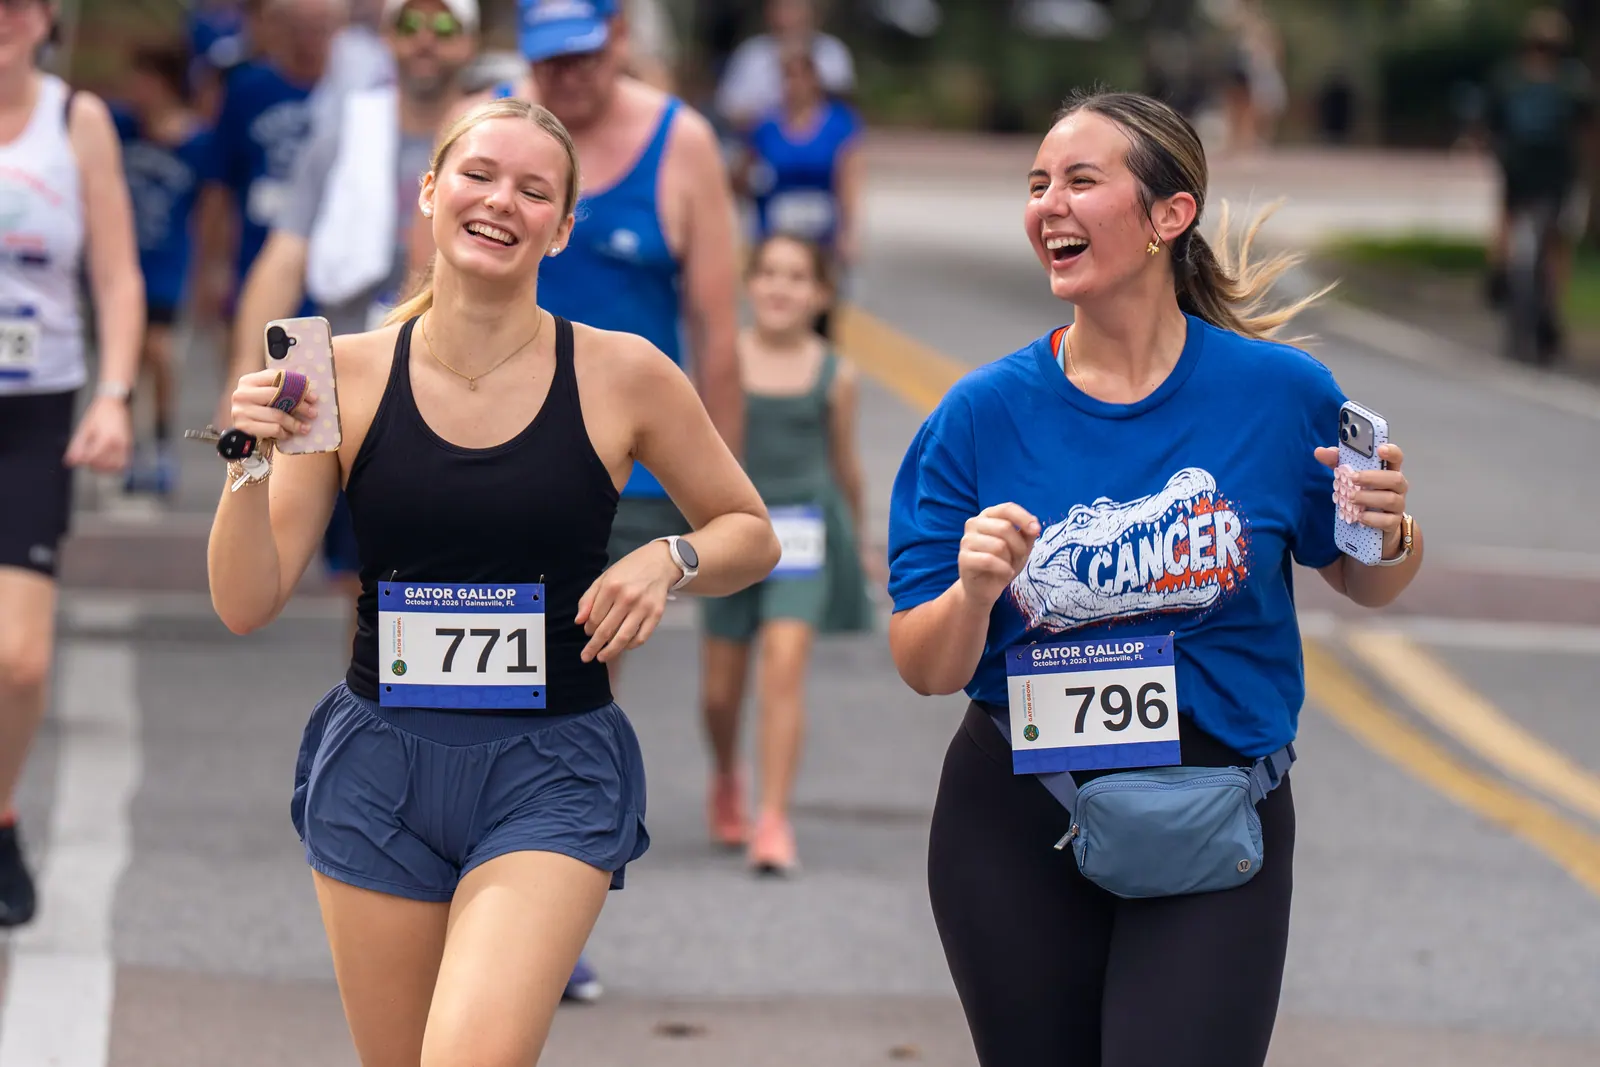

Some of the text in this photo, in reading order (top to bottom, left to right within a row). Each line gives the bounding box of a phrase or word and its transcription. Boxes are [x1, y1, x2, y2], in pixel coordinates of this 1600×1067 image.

[1088, 510, 1242, 597] CANCER
[404, 586, 517, 600] GATOR GALLOP
[435, 628, 538, 673] 771
[1031, 641, 1145, 660] GATOR GALLOP
[1070, 657, 1087, 665] 2026
[1093, 655, 1133, 663] Gainesville,
[1065, 681, 1169, 734] 796
